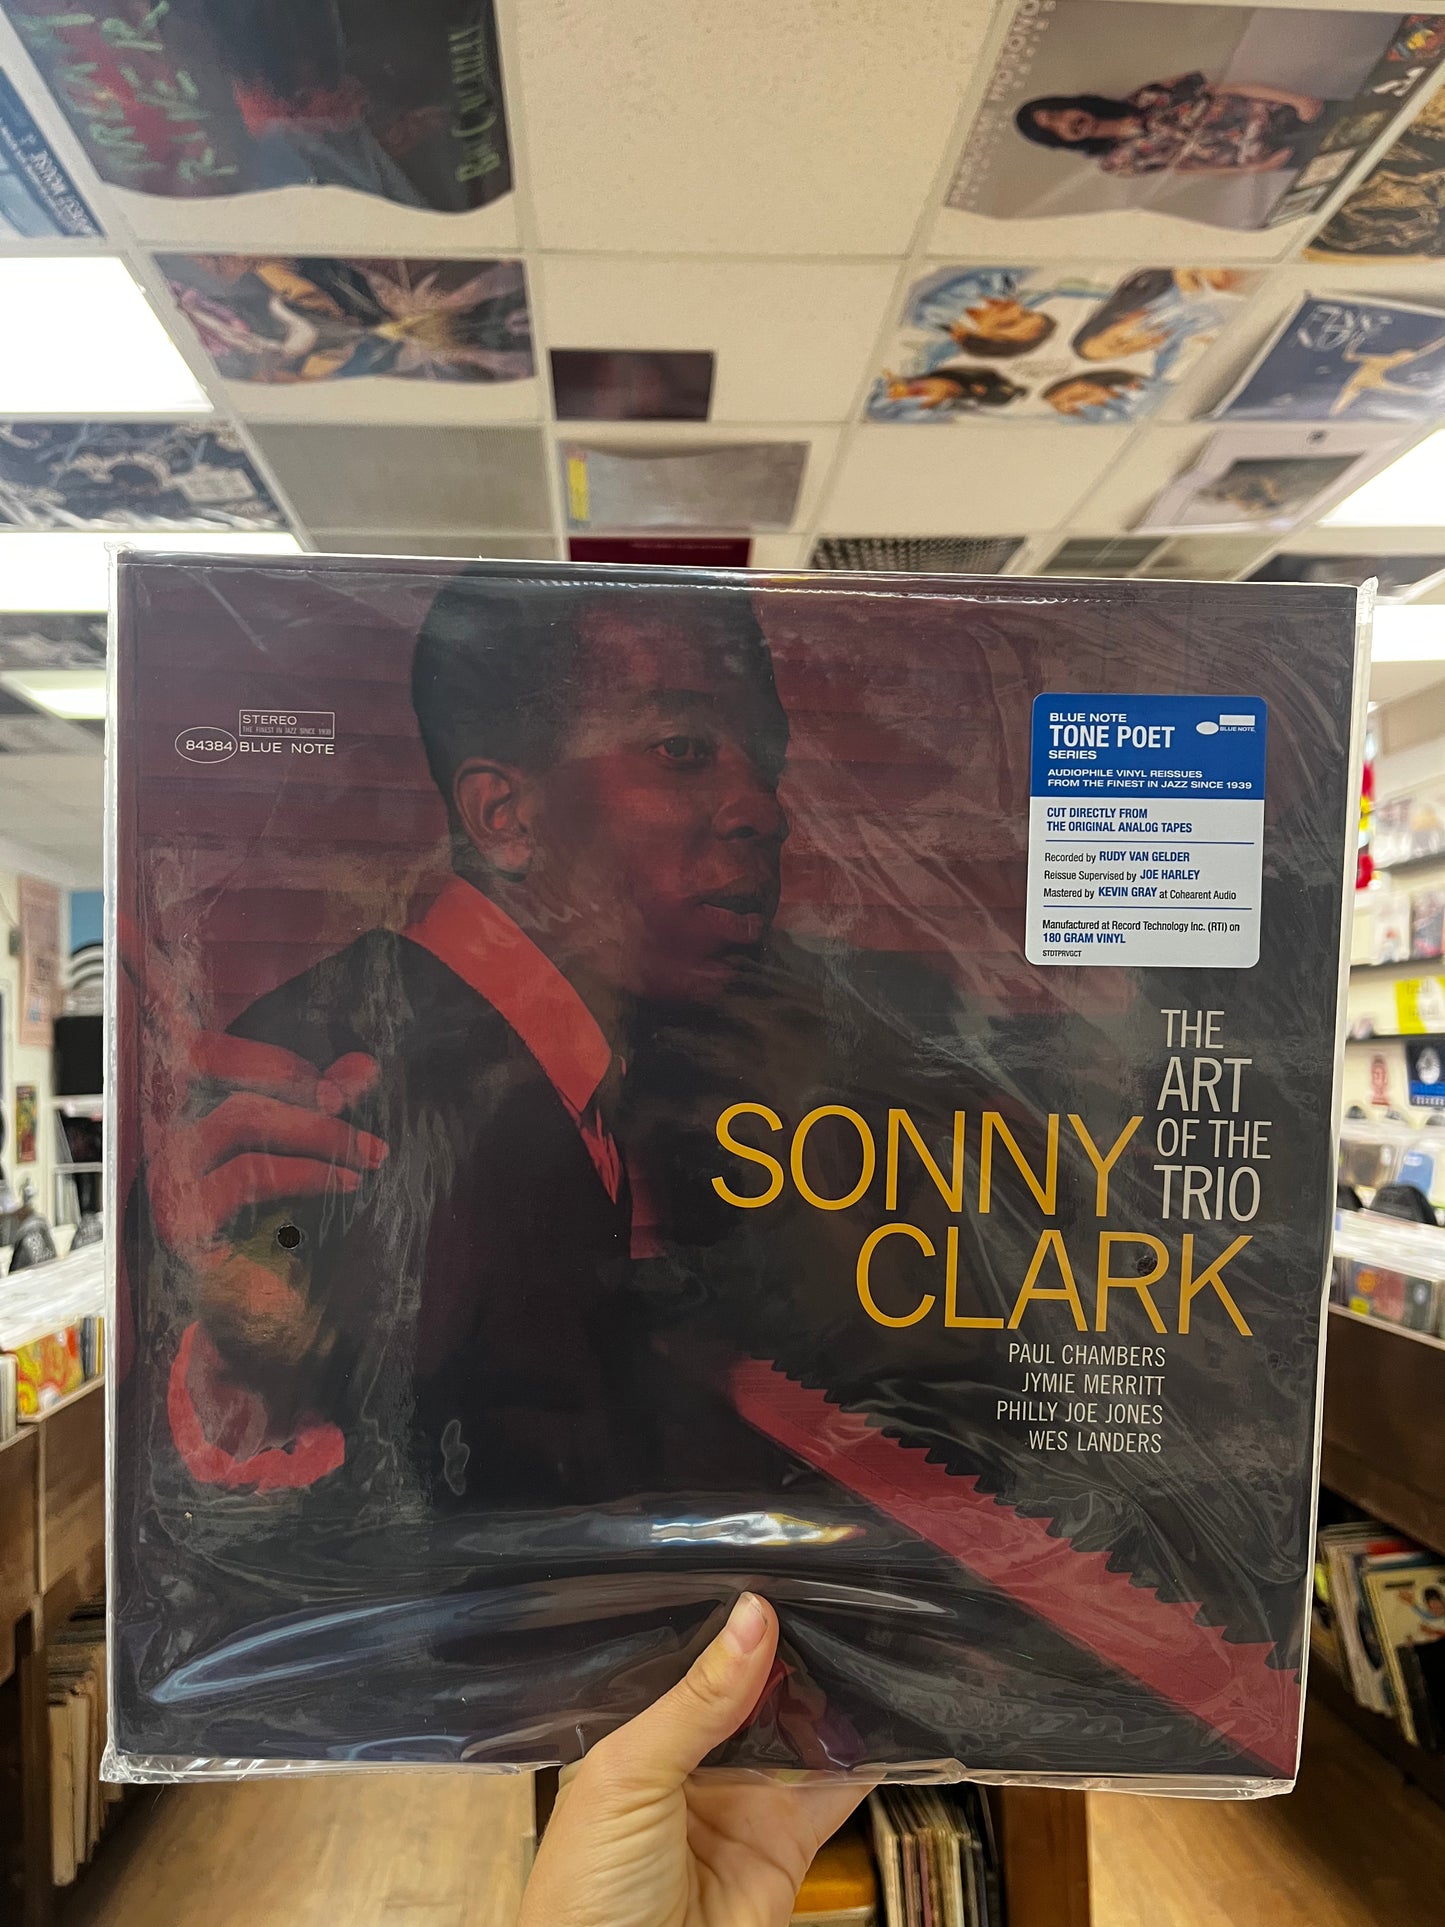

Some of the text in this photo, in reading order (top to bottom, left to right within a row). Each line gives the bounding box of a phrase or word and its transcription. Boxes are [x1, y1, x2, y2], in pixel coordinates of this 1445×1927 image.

[243, 715, 297, 725] STEREO
[1050, 713, 1126, 722] BLUE NOTE
[1050, 725, 1175, 748] TONE POET
[186, 740, 232, 751] 84384
[240, 742, 334, 754] BLUE NOTE
[1049, 750, 1096, 759] SERIES
[1048, 769, 1113, 777] AUDIOPHILE
[1150, 770, 1202, 778] REISSUES
[1106, 780, 1145, 788] FINEST
[1047, 808, 1148, 818] CUT DIRECTLY FROM
[1047, 822, 1192, 833] THE ORIGINAL ANALOG TAPES
[1045, 852, 1190, 864] Recorded by RUDY VAN GELDER
[1044, 870, 1200, 882] Reissue Supervised by JOE HARLEY
[1044, 887, 1236, 900] Mastered by KEVIN GRAY at Cohearent Audio
[1043, 920, 1240, 933] Manufactured at Record Technology Inc. (RTI) on
[1043, 933, 1126, 944] 180 GRAM VINYL
[1161, 1009, 1224, 1049] THE
[1157, 1057, 1252, 1113] ART
[1157, 1118, 1272, 1159] OF THE
[710, 1102, 1143, 1217] SONNY
[1154, 1164, 1261, 1222] TRIO
[855, 1223, 1253, 1336] CLARK
[1009, 1344, 1166, 1367] PAUL CHAMBERS
[1021, 1373, 1165, 1396] JYMIE MERRITT
[996, 1400, 1163, 1425] PHILLY JOE JONES
[1028, 1430, 1162, 1453] WES LANDERS
